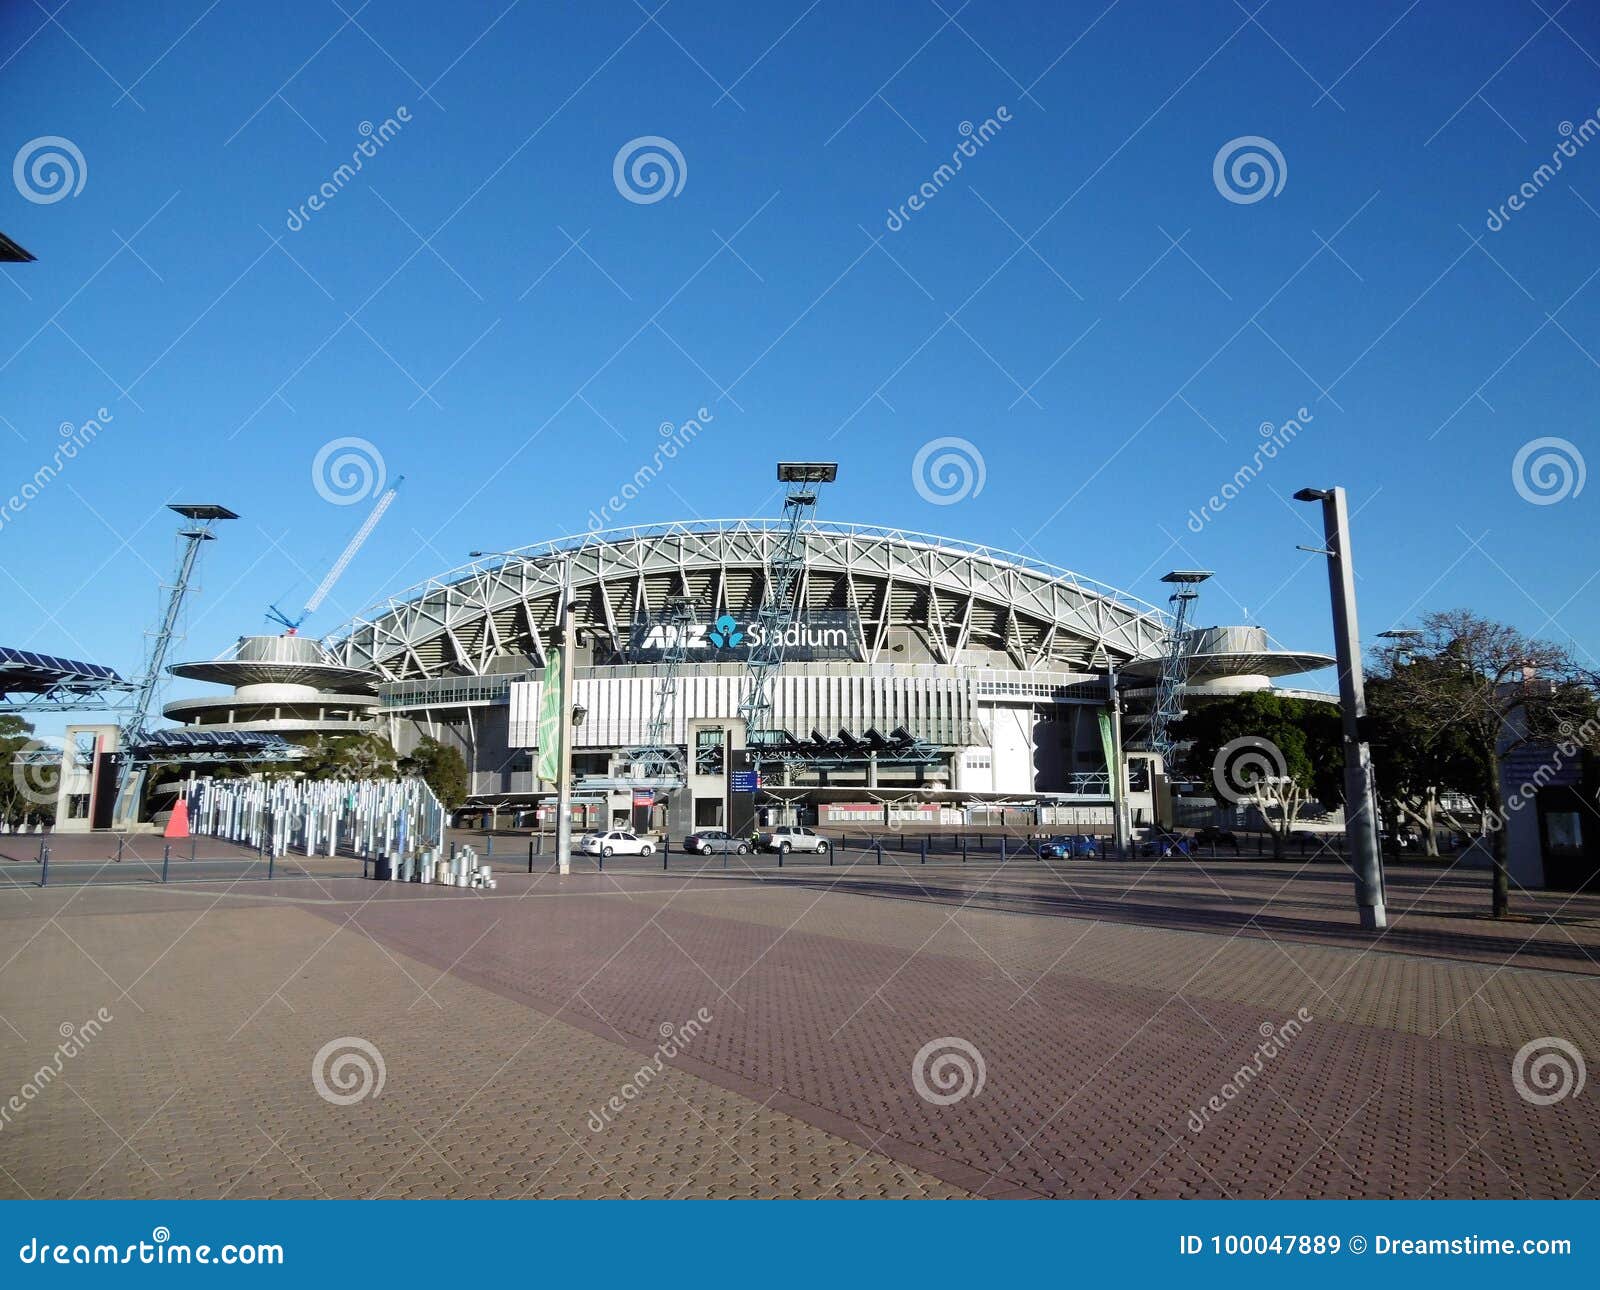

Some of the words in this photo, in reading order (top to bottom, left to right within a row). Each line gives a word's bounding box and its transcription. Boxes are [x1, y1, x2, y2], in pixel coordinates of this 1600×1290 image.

[641, 625, 707, 648] ANZ
[747, 623, 848, 648] Stadium
[110, 754, 116, 764] 2
[745, 752, 750, 763] 3
